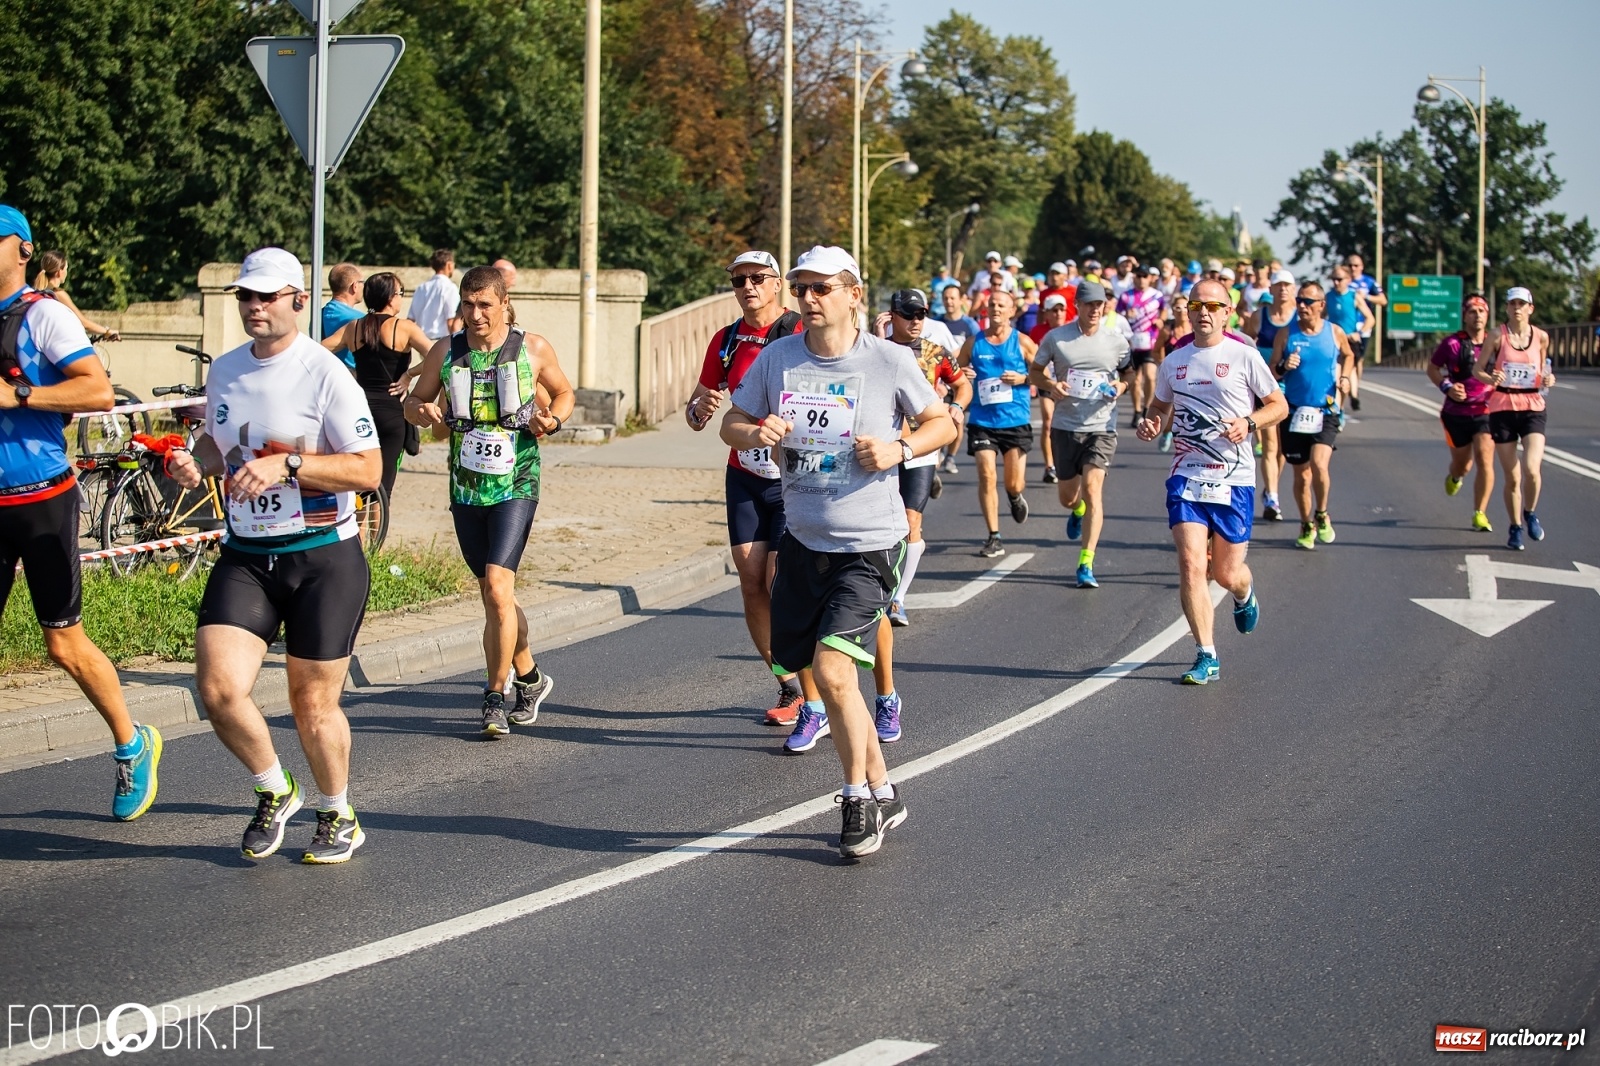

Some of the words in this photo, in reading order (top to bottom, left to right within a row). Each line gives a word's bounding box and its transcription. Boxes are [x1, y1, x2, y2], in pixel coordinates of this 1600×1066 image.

[1512, 370, 1528, 379] 372
[1082, 379, 1093, 388] 15
[990, 385, 1000, 393] 87
[807, 409, 829, 428] 96
[1300, 413, 1314, 423] 341
[356, 424, 373, 434] EPK
[475, 442, 502, 458] 358
[249, 493, 282, 514] 195
